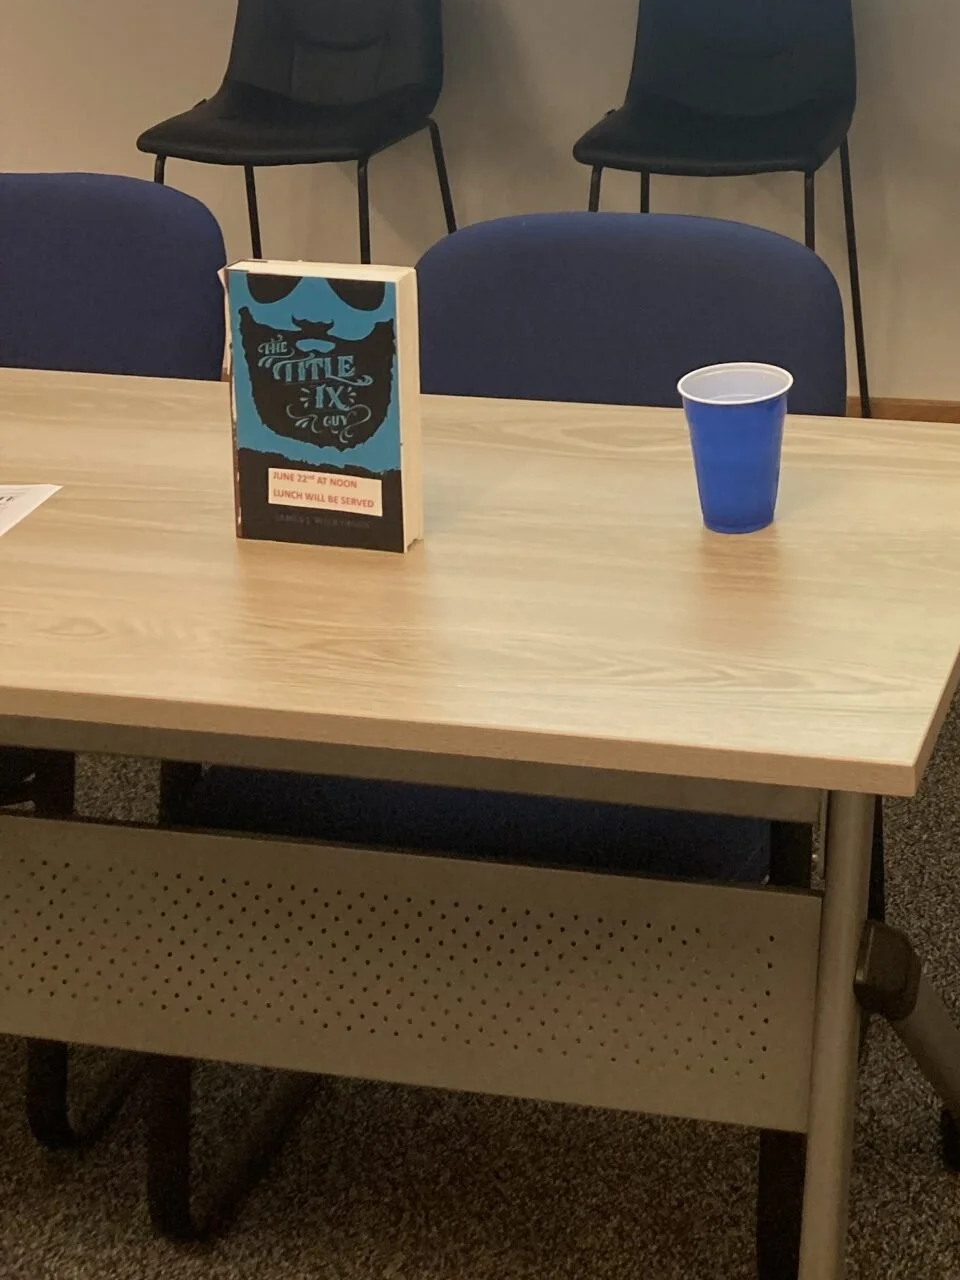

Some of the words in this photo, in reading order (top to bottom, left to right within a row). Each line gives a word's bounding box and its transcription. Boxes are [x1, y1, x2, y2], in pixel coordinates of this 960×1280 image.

[257, 335, 290, 357] THE
[272, 353, 373, 386] TITLE
[315, 384, 350, 411] IX
[322, 414, 350, 428] GUY
[273, 471, 295, 482] JUNE
[317, 476, 327, 485] AT
[329, 478, 358, 489] NOON
[273, 488, 303, 500] LUNCH
[305, 492, 326, 503] WILL
[328, 495, 339, 504] BE
[340, 496, 375, 508] SERVED
